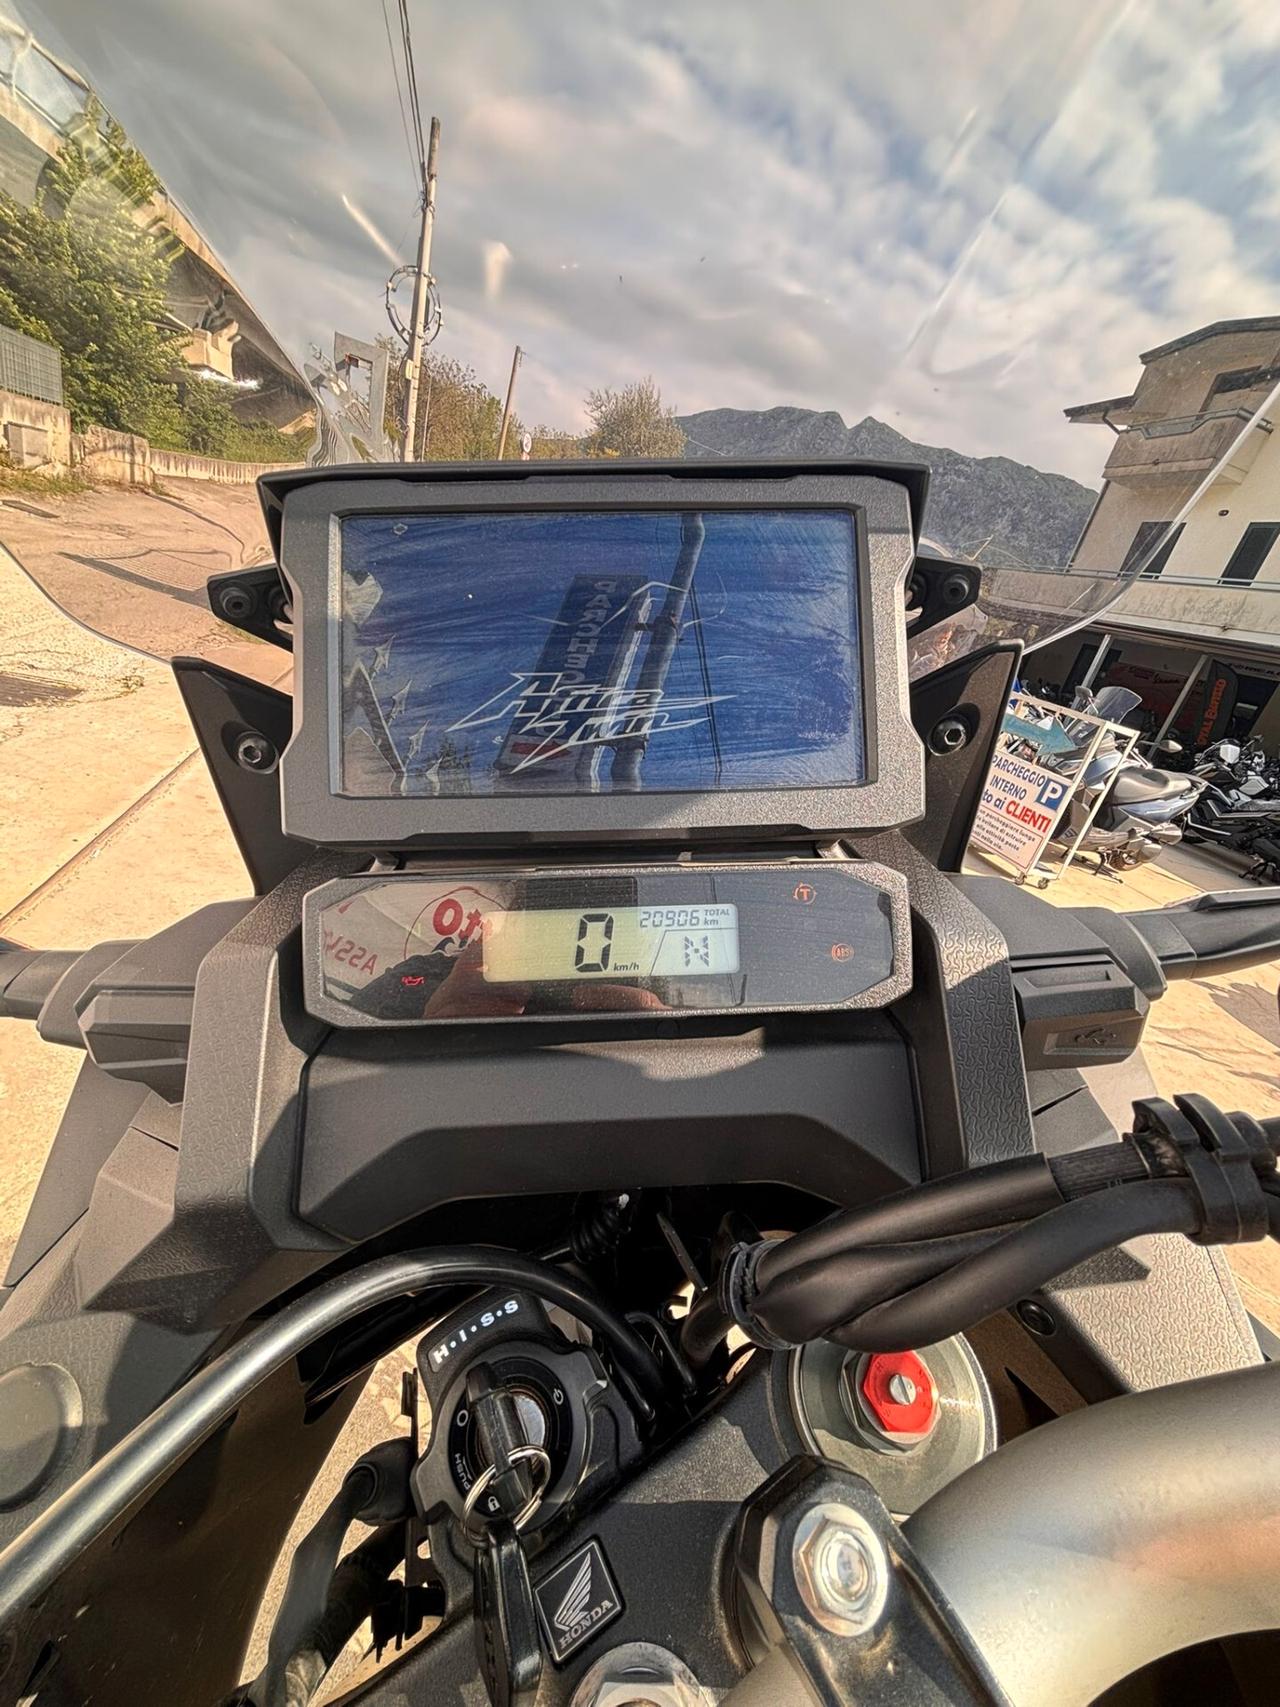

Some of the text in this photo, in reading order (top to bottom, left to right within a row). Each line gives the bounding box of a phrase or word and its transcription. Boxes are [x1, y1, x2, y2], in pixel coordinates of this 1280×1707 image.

[989, 774, 1028, 801] INTERNO
[1040, 781, 1063, 804] P
[993, 797, 1006, 810] ai
[1005, 799, 1052, 833] CLIENTI
[639, 908, 730, 928] 20906 TOTAL
[703, 918, 719, 926] km
[575, 913, 640, 972] 0 km/h
[683, 935, 710, 967] N
[558, 1599, 613, 1650] HONDA
